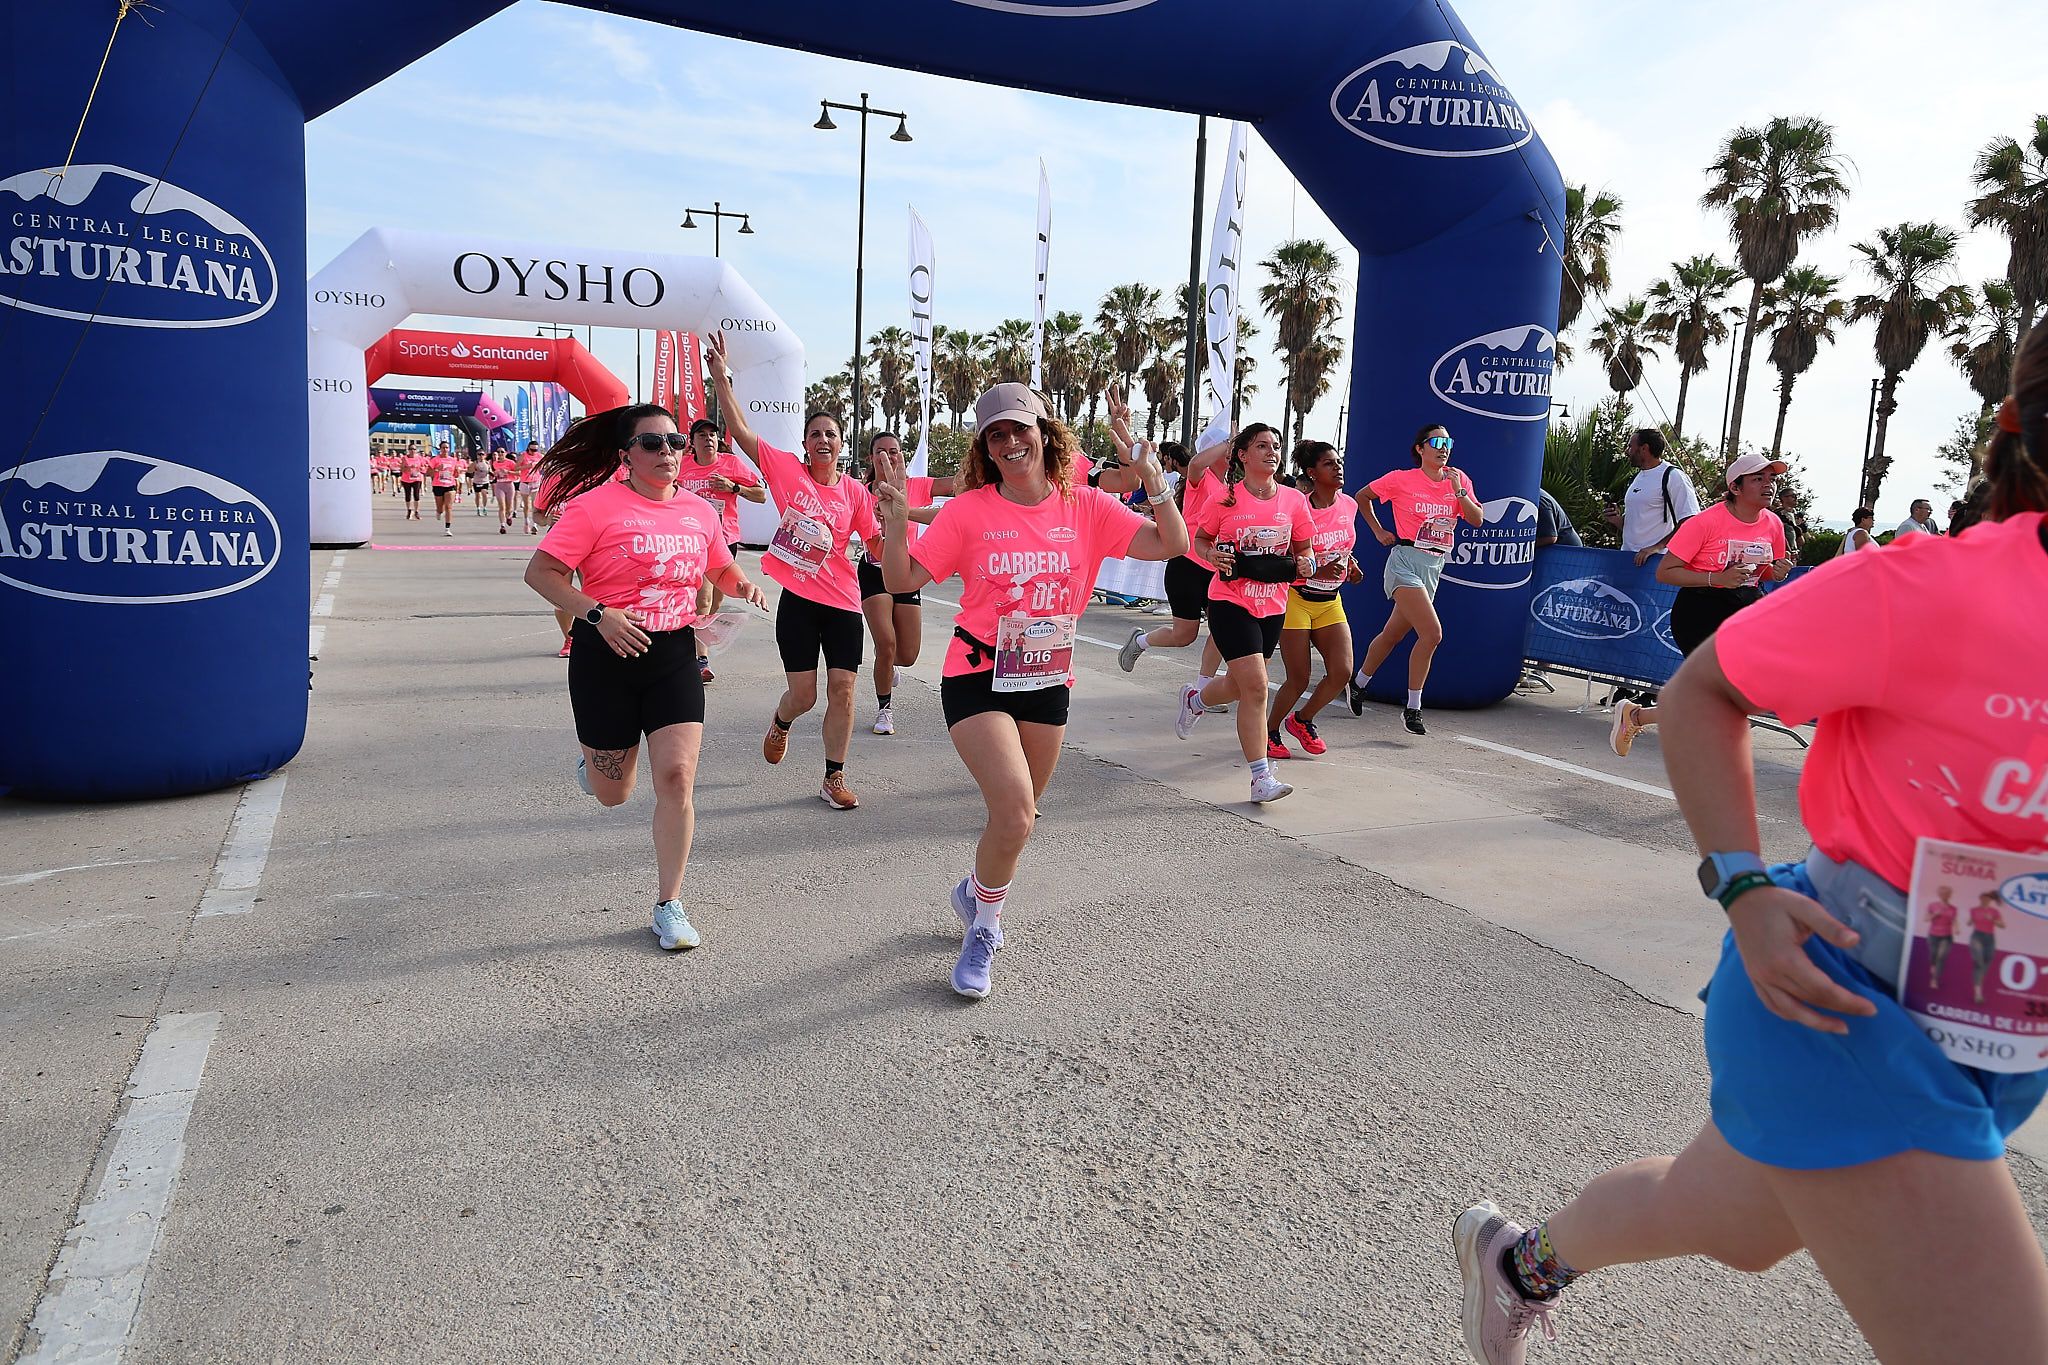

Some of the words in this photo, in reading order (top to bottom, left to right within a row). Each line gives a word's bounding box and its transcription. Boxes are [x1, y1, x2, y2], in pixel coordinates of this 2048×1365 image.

[1395, 77, 1465, 92] CENTRAL
[1348, 79, 1529, 133] ASTURIANA
[12, 212, 129, 237] CENTRAL
[142, 225, 252, 260] LECHERA
[453, 252, 666, 308] OYSHO
[314, 290, 386, 308] OYSHO
[720, 318, 777, 333] OYSHO
[399, 340, 449, 358] Sports
[472, 345, 549, 361] Santander
[1481, 356, 1536, 367] CENTRAL
[308, 378, 353, 393] SHO
[1444, 357, 1553, 397] ASTURIA
[749, 400, 801, 414] OYSHO
[22, 499, 136, 519] CENTRAL
[148, 506, 256, 524] LECHERA
[1415, 502, 1453, 516] CARRERA
[982, 530, 1019, 540] OYSHO
[1312, 528, 1350, 546] CARRERA
[1461, 528, 1516, 538] CENTRAL
[633, 534, 701, 554] CARRERA
[791, 536, 812, 552] 016
[988, 551, 1071, 575] CARRERA
[1244, 582, 1278, 599] MUJER
[1538, 594, 1631, 631] ASTURIANA
[1023, 650, 1052, 664] 016
[1002, 680, 1028, 688] OYSHO
[1941, 861, 1997, 881] SUMA
[1926, 1002, 1991, 1027] CARRERA
[1995, 1016, 2015, 1031] DE
[2015, 1019, 2034, 1034] LA
[1926, 1026, 2016, 1060] OYSHO
